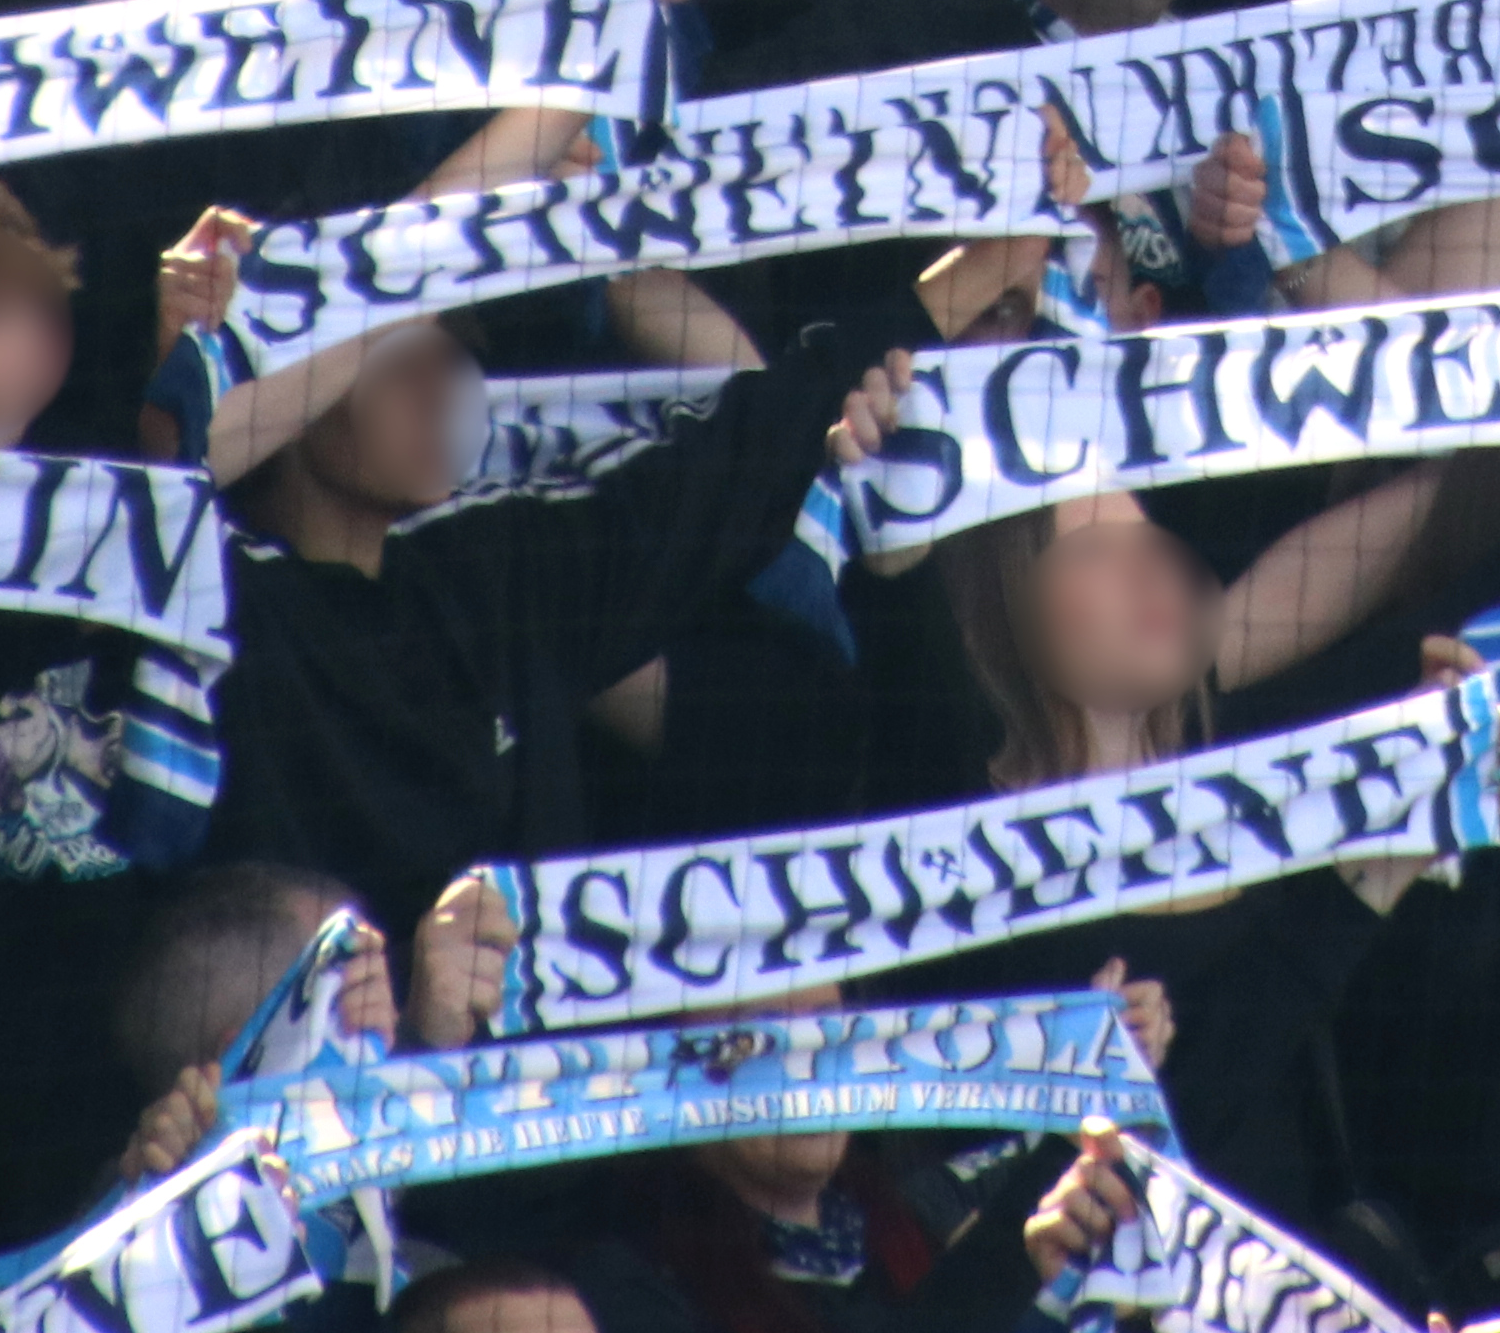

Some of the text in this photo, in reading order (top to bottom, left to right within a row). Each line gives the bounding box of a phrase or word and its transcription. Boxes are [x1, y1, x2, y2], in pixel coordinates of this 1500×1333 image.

[549, 726, 1429, 1002] SCHWEINE
[426, 1125, 506, 1168] WIE
[511, 1105, 647, 1152] HEUTE
[676, 1082, 898, 1131] ABSCHAUM
